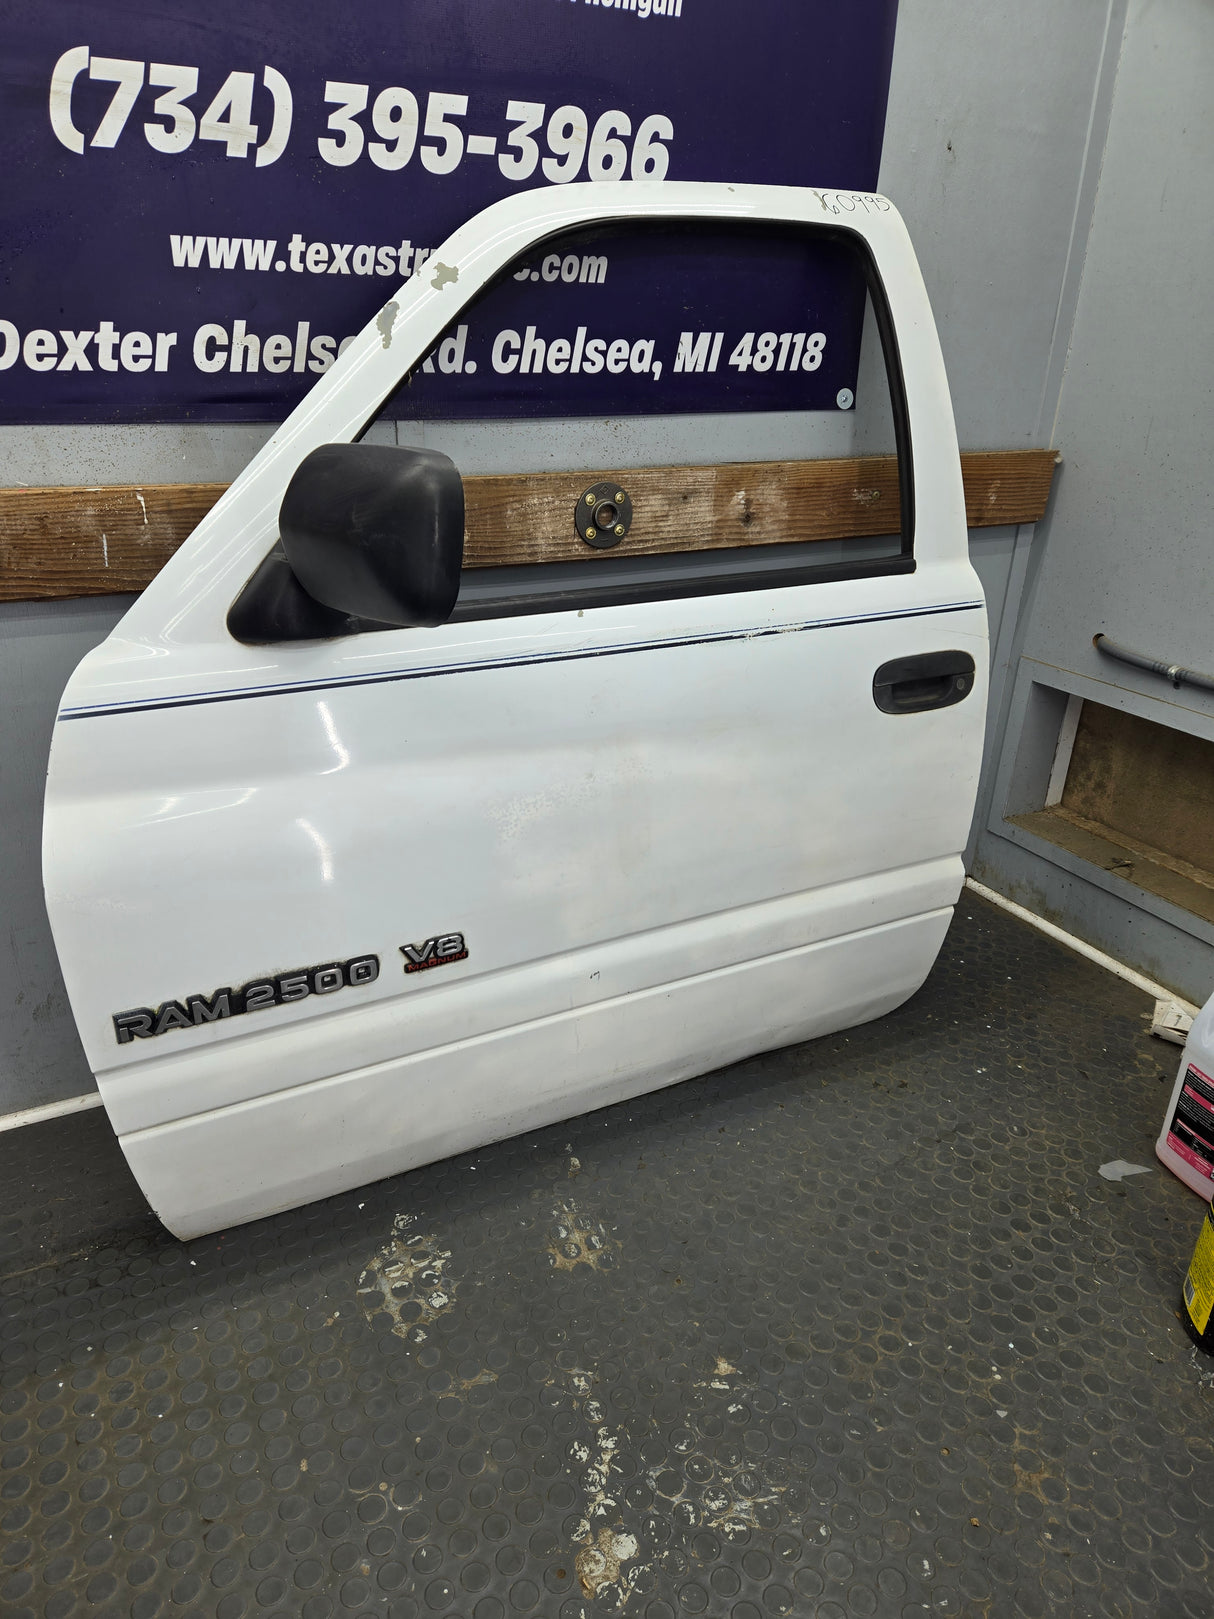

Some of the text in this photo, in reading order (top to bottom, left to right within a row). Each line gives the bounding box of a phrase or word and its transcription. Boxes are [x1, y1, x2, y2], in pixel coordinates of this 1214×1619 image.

[49, 45, 674, 183] (734) 395-3966
[192, 319, 357, 374] Chels
[416, 324, 478, 375] d.
[491, 325, 663, 381] Chelsea,
[673, 331, 725, 373] MI
[728, 331, 827, 372] 48118
[401, 933, 464, 963] V8
[406, 951, 467, 973] MAGNUM
[114, 955, 380, 1044] RAM 2500
